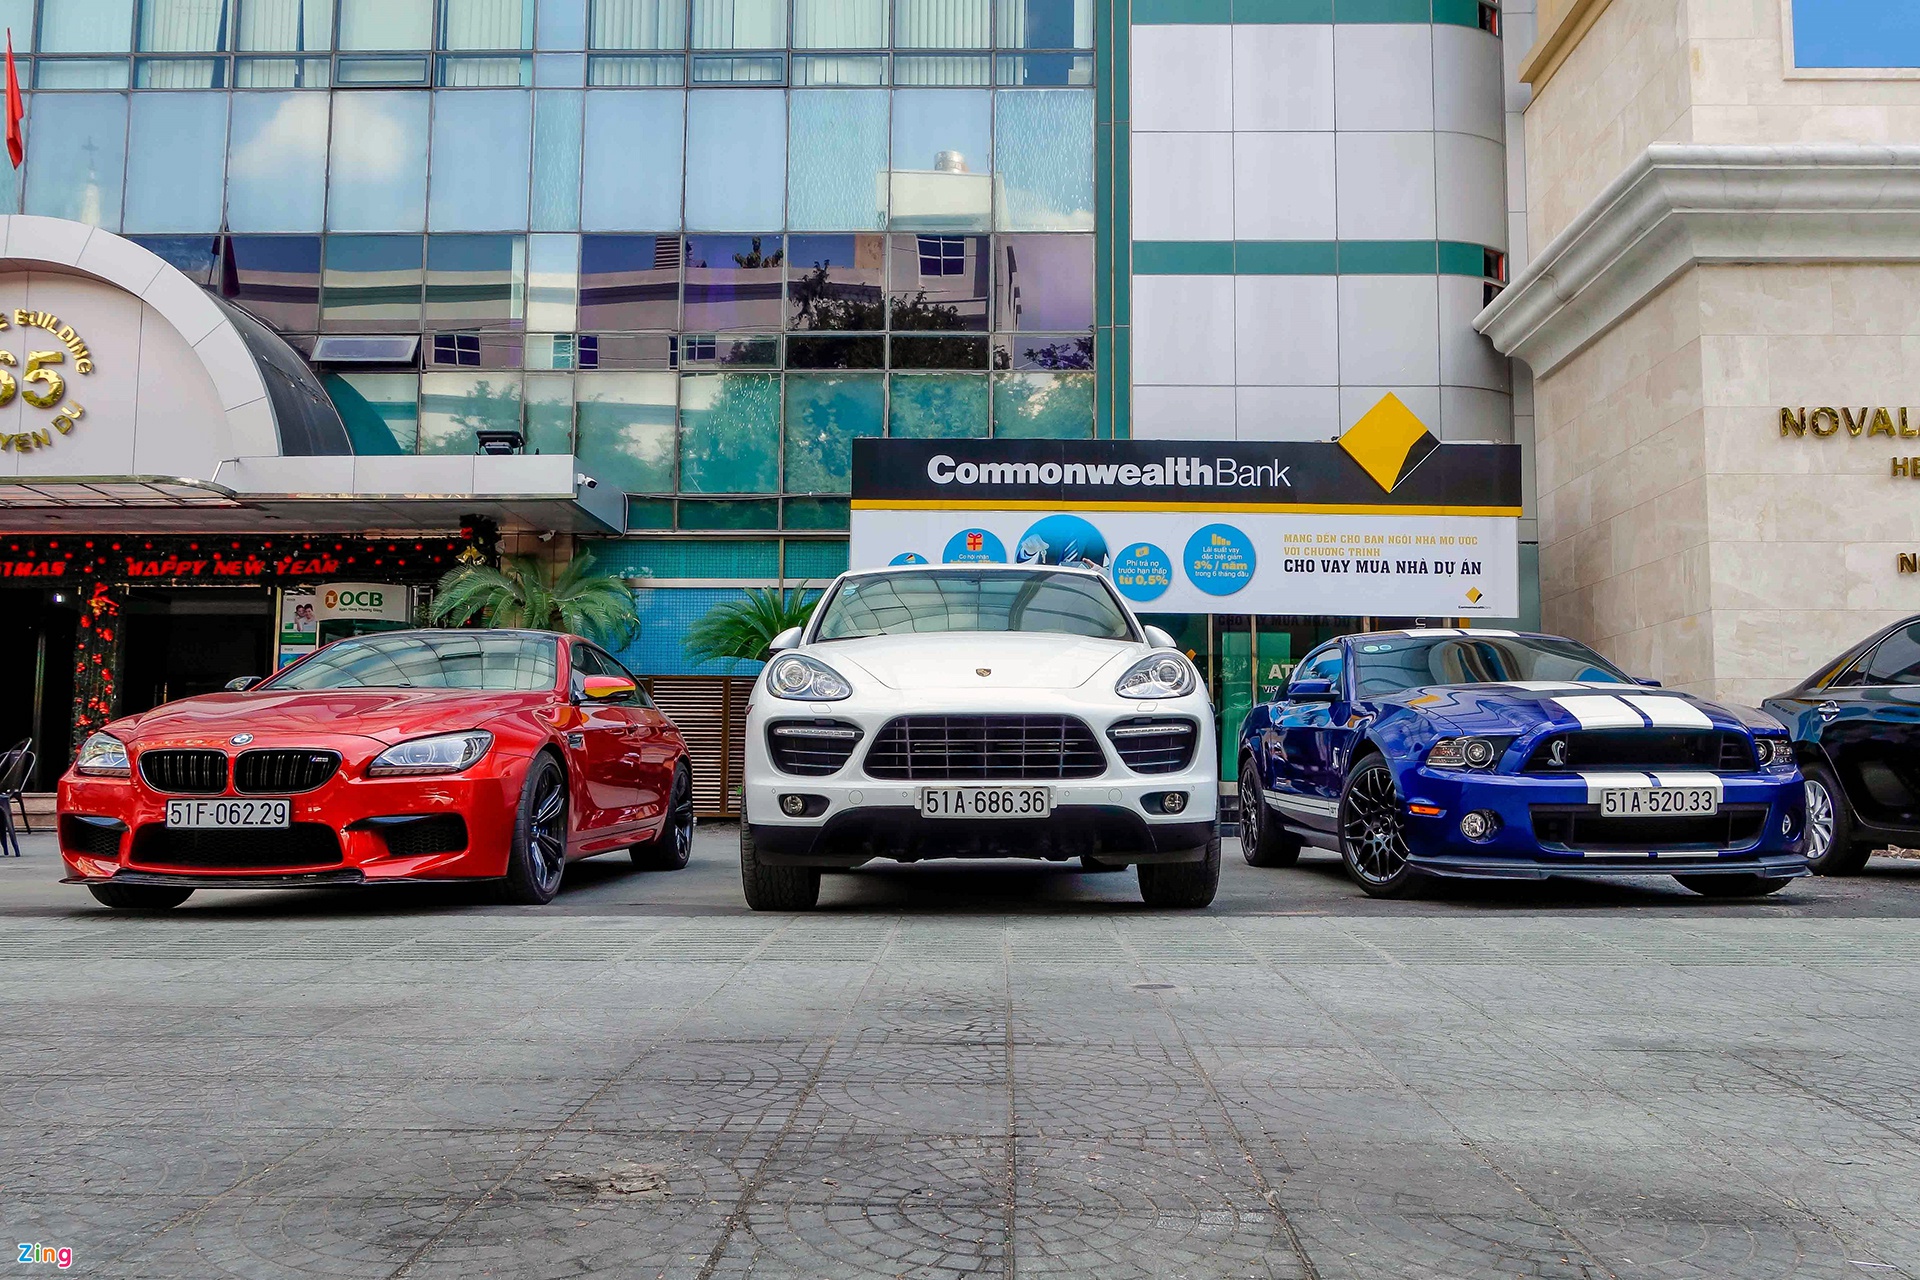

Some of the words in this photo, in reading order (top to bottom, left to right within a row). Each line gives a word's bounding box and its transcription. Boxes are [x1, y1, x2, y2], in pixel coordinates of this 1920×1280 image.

[14, 308, 93, 374] BUILDING
[1779, 406, 1920, 437] NOVAL
[1283, 534, 1313, 543] MANG
[1340, 534, 1361, 544] CHO
[0, 561, 66, 577] TMAS
[127, 560, 208, 577] HAPPY
[213, 560, 266, 576] NEW
[275, 558, 340, 576] YEAR
[1194, 560, 1213, 570] 3%
[1284, 559, 1316, 573] CHO
[1320, 559, 1351, 573] VAY
[1355, 560, 1391, 574] MUA
[1395, 557, 1429, 574] NHÀ
[1433, 561, 1456, 577] DỰ
[1460, 558, 1482, 575] ÁN
[1135, 575, 1169, 586] 0,5%
[339, 590, 383, 607] OCB
[1268, 664, 1297, 679] AT
[926, 790, 1045, 814] 51A-686.36
[1605, 790, 1713, 813] 51A-520.33
[169, 802, 286, 826] 51F-062.29
